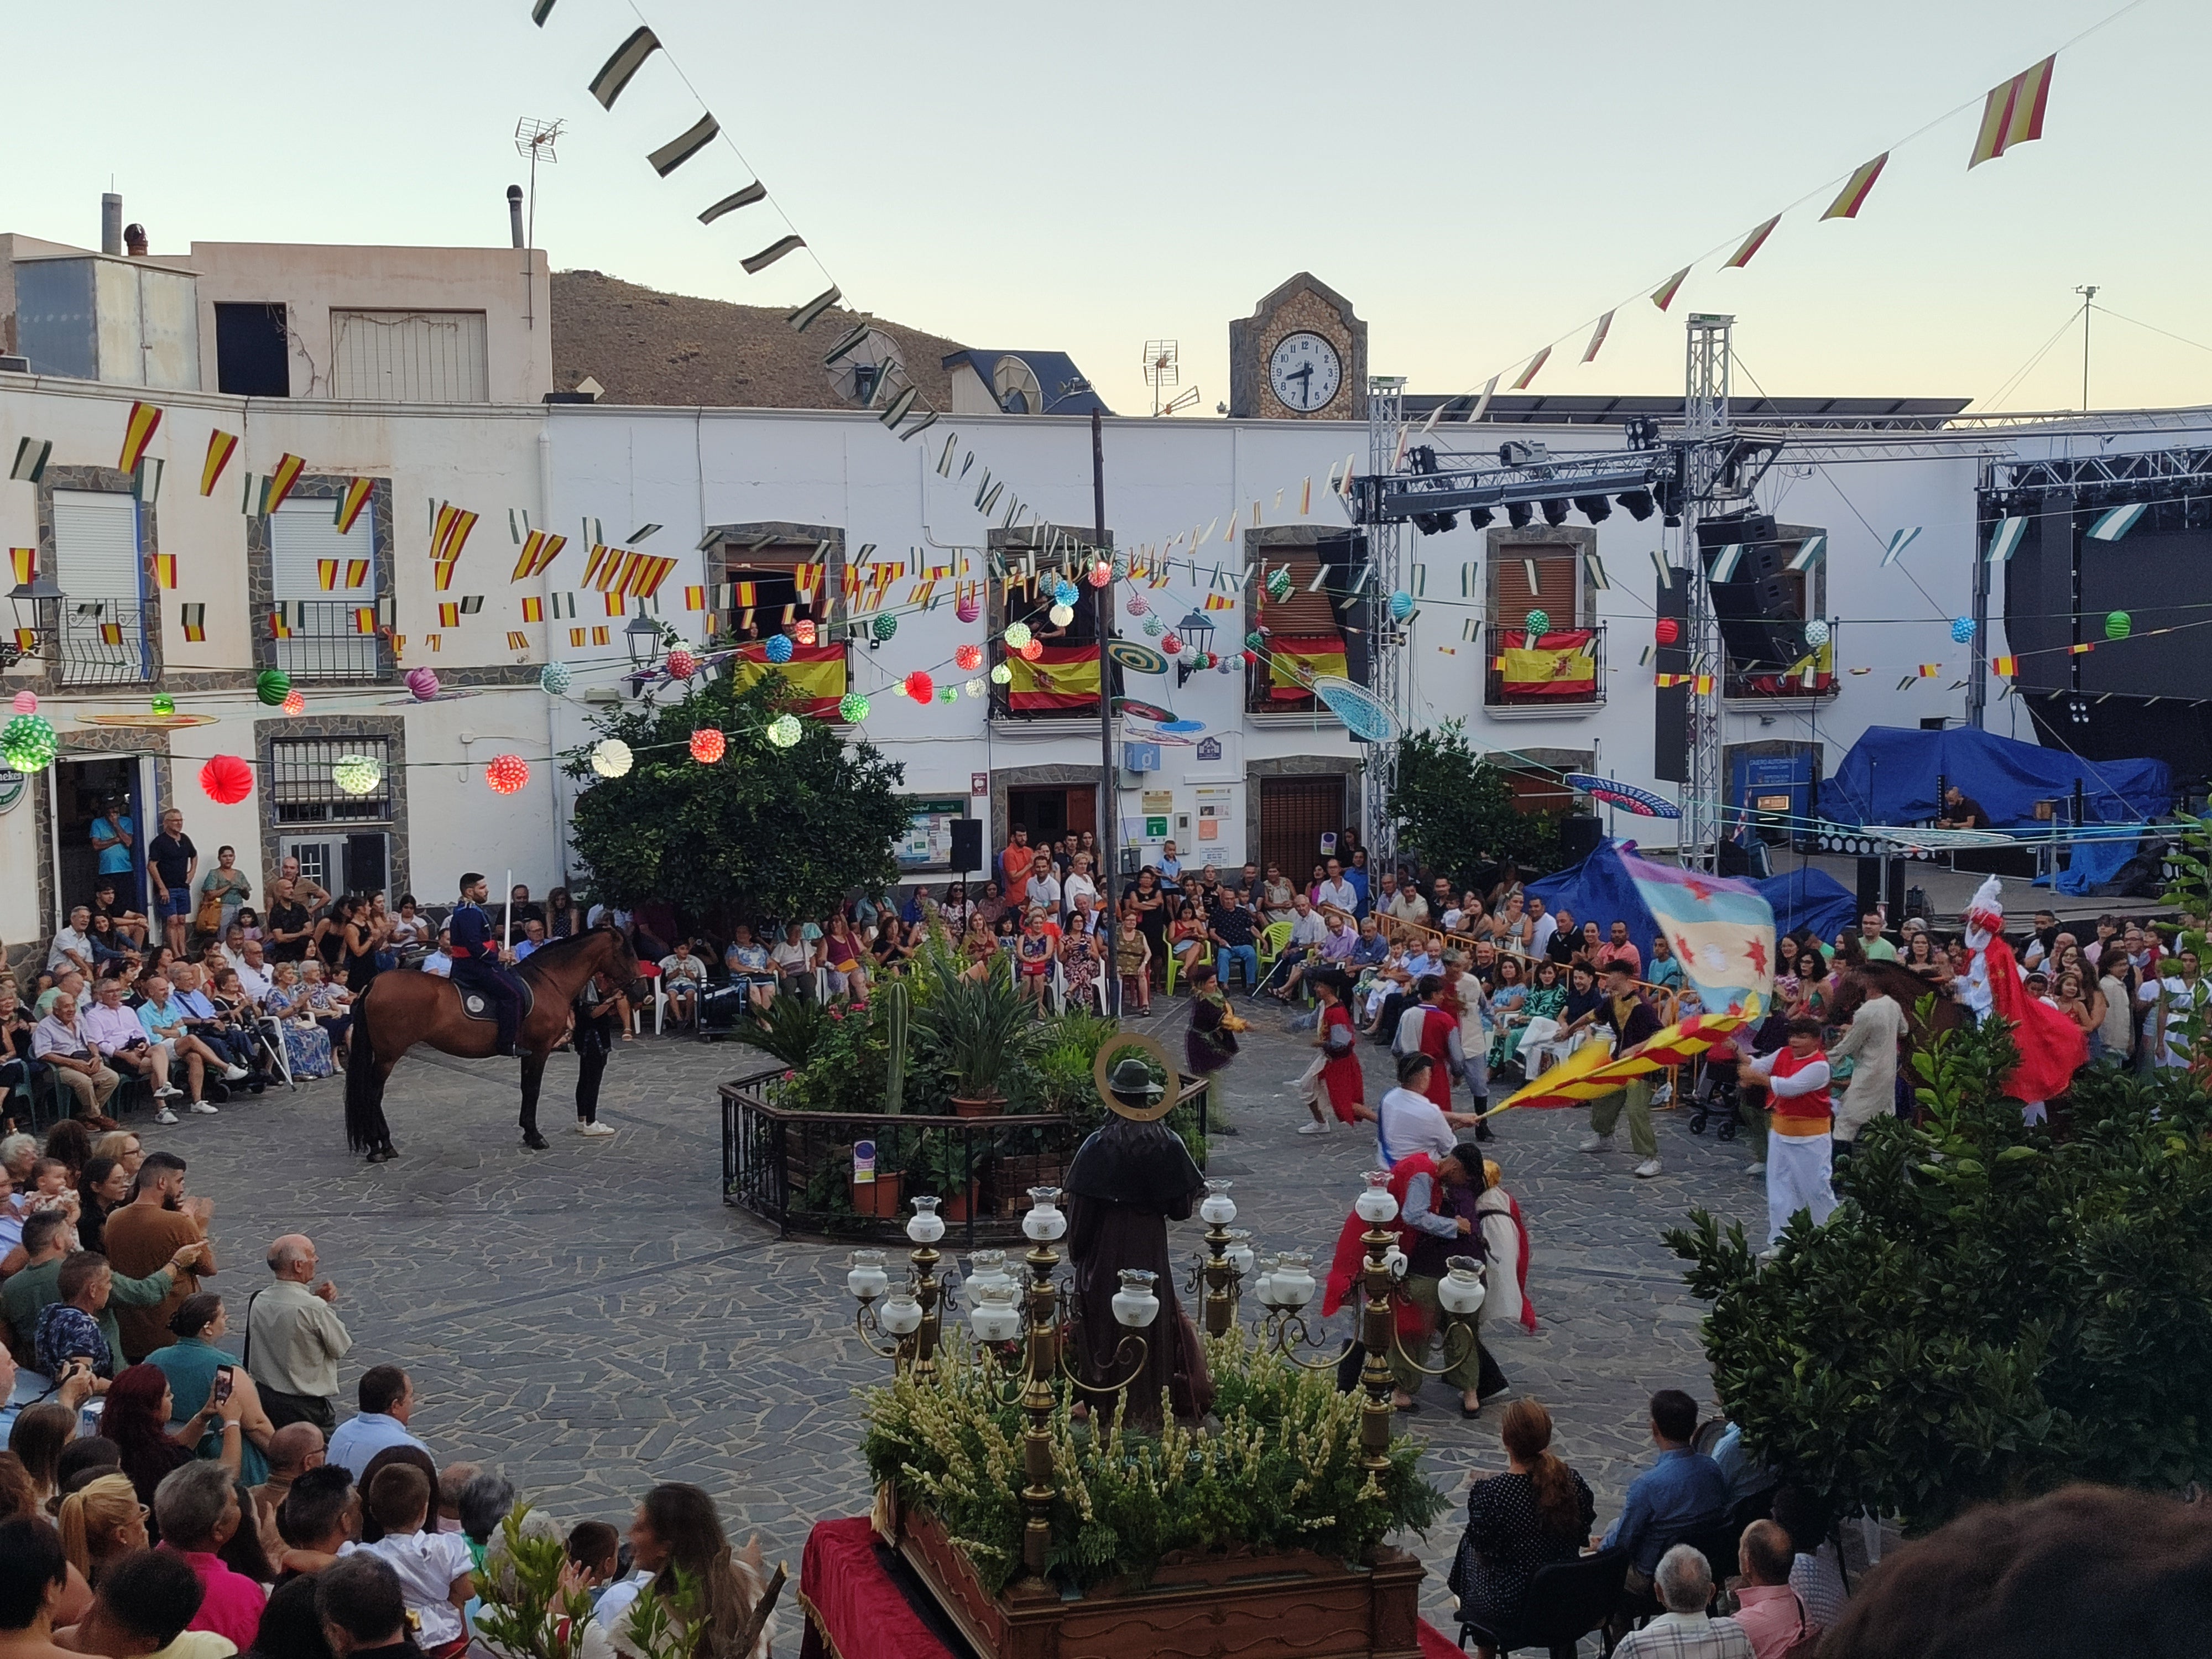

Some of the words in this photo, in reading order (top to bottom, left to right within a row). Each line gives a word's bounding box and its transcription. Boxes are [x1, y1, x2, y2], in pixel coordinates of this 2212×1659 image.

[1290, 344, 1296, 353] 11
[1301, 341, 1309, 349] 12
[1316, 345, 1319, 354] 1
[1280, 354, 1289, 363] 10
[1324, 354, 1329, 363] 2
[1276, 368, 1282, 377] 9
[1328, 368, 1333, 377] 3
[1280, 382, 1286, 391] 8
[1323, 382, 1328, 392] 4
[1291, 392, 1296, 400] 7
